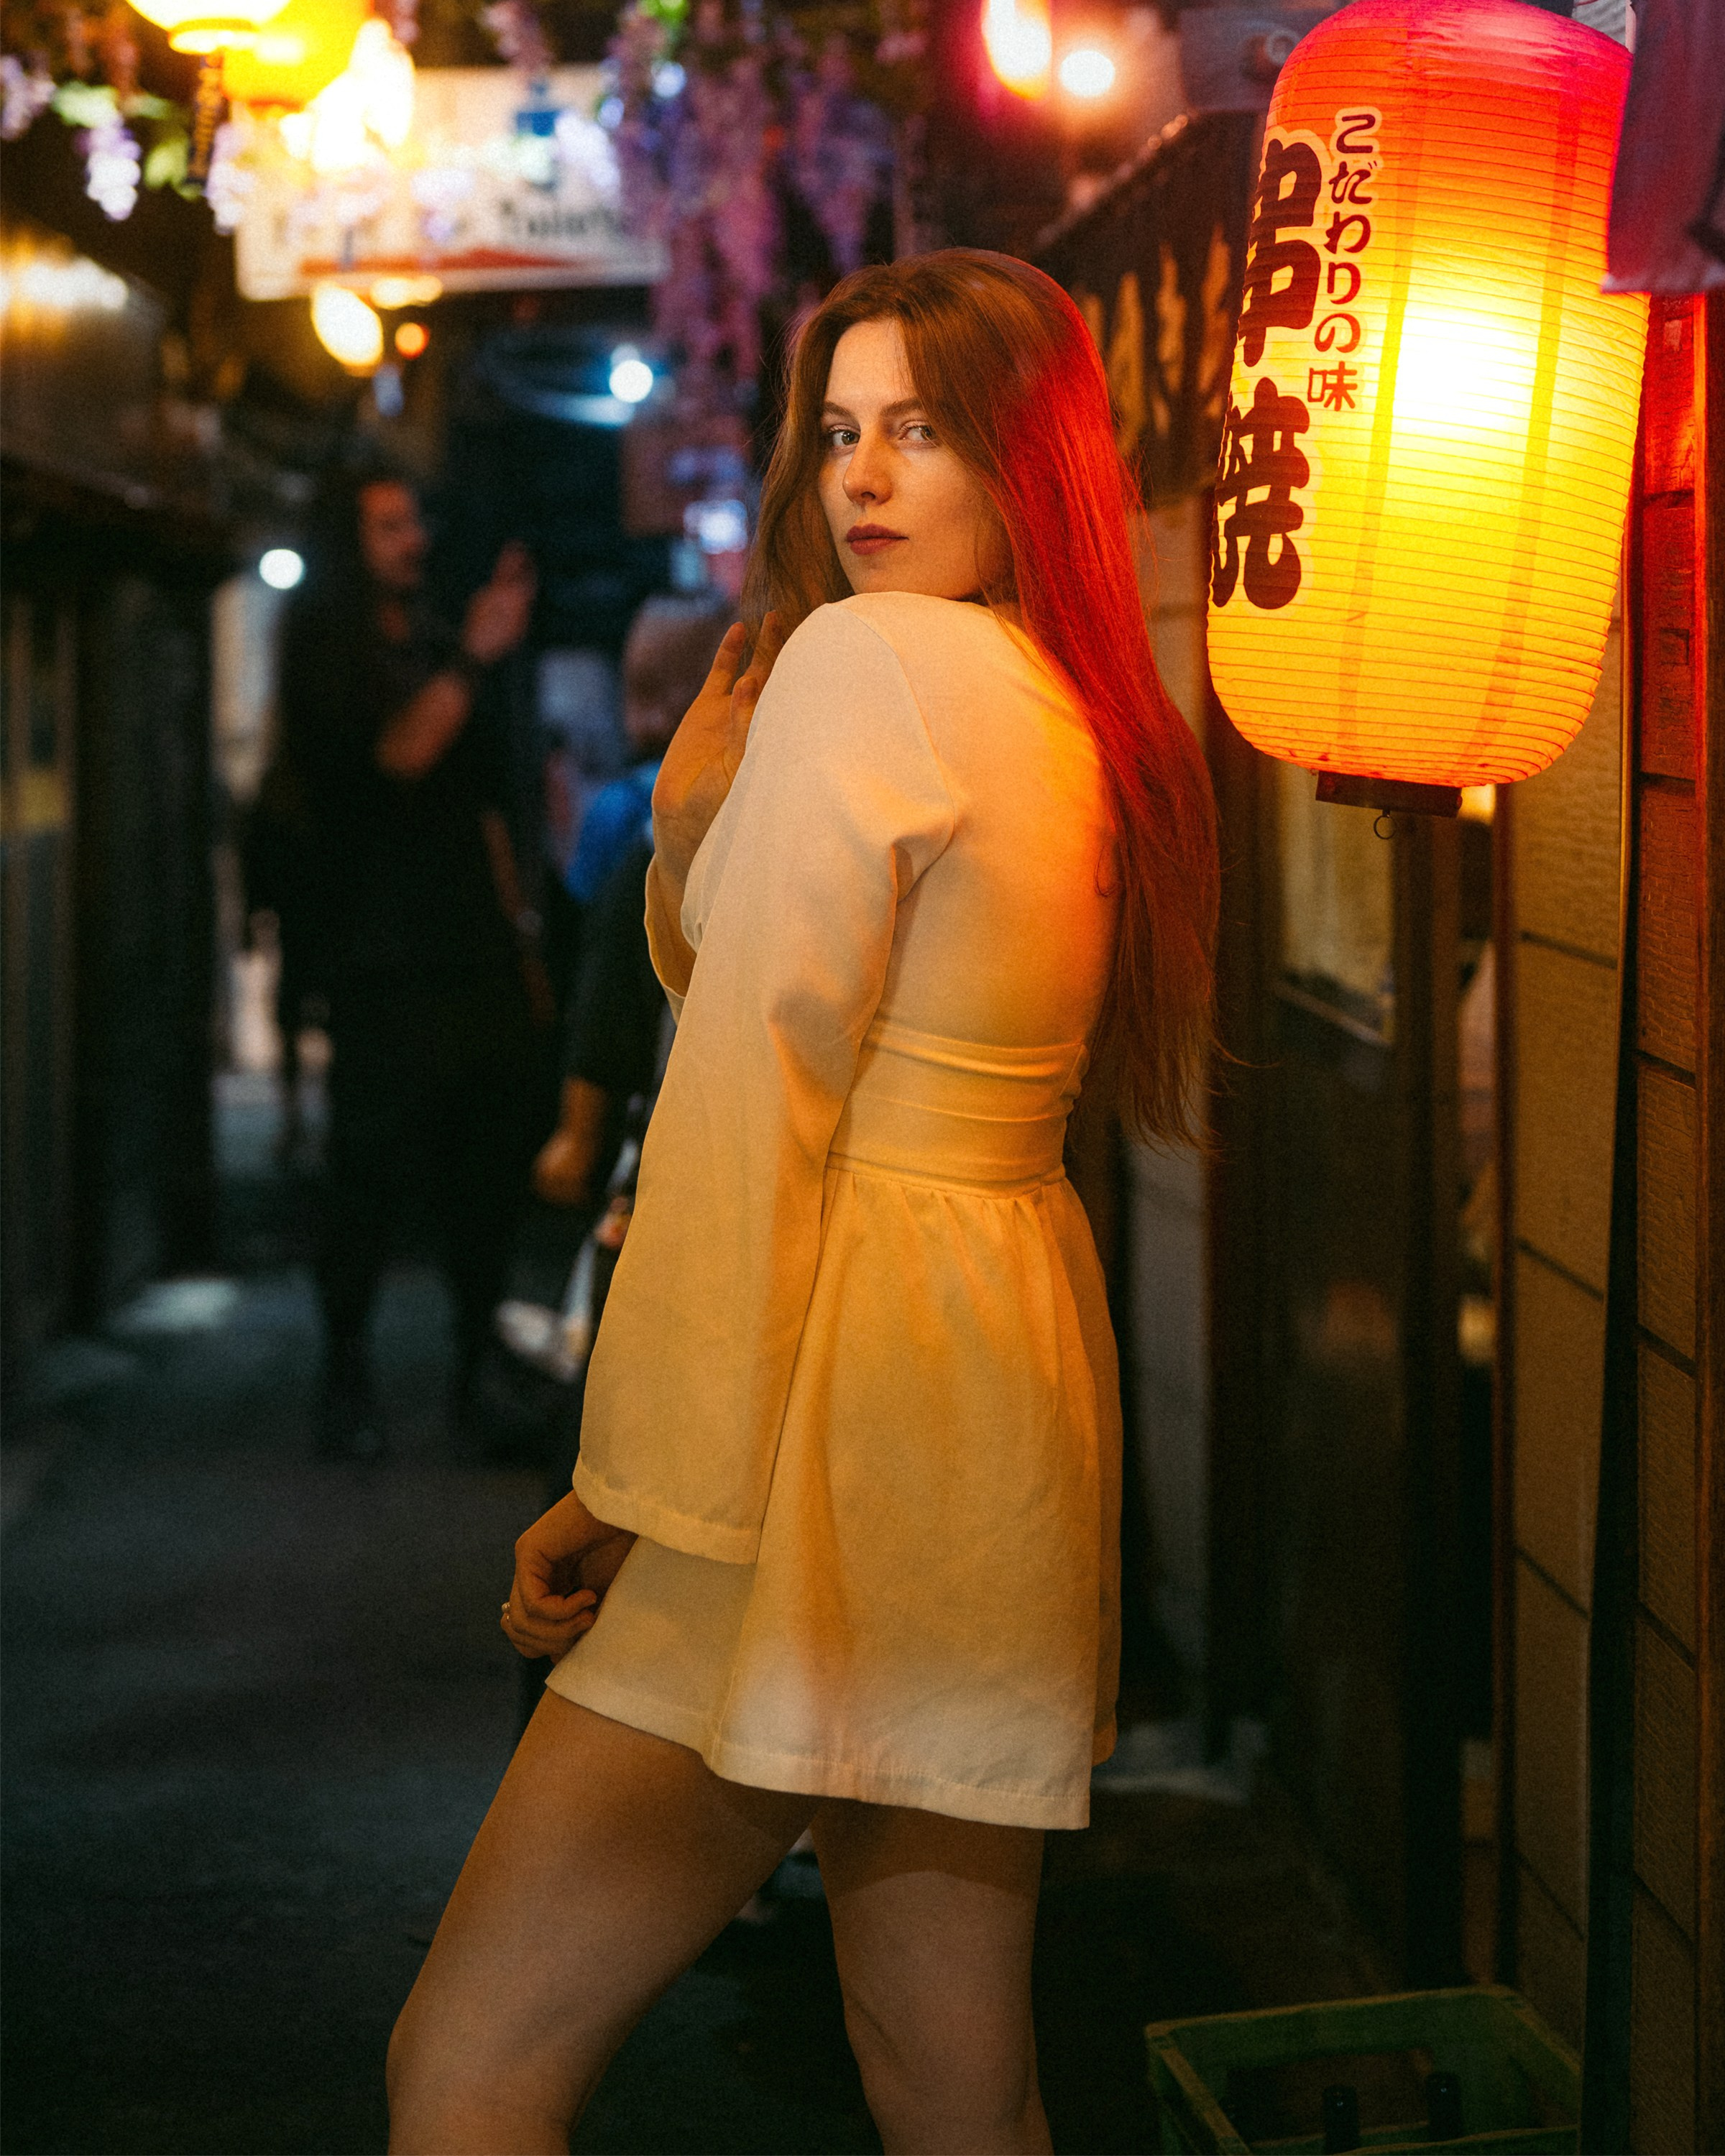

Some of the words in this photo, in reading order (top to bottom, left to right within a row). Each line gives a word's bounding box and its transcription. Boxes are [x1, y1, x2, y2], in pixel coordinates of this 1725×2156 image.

[1210, 138, 1322, 610] 串焼
[1307, 113, 1377, 412] こだわりの味
